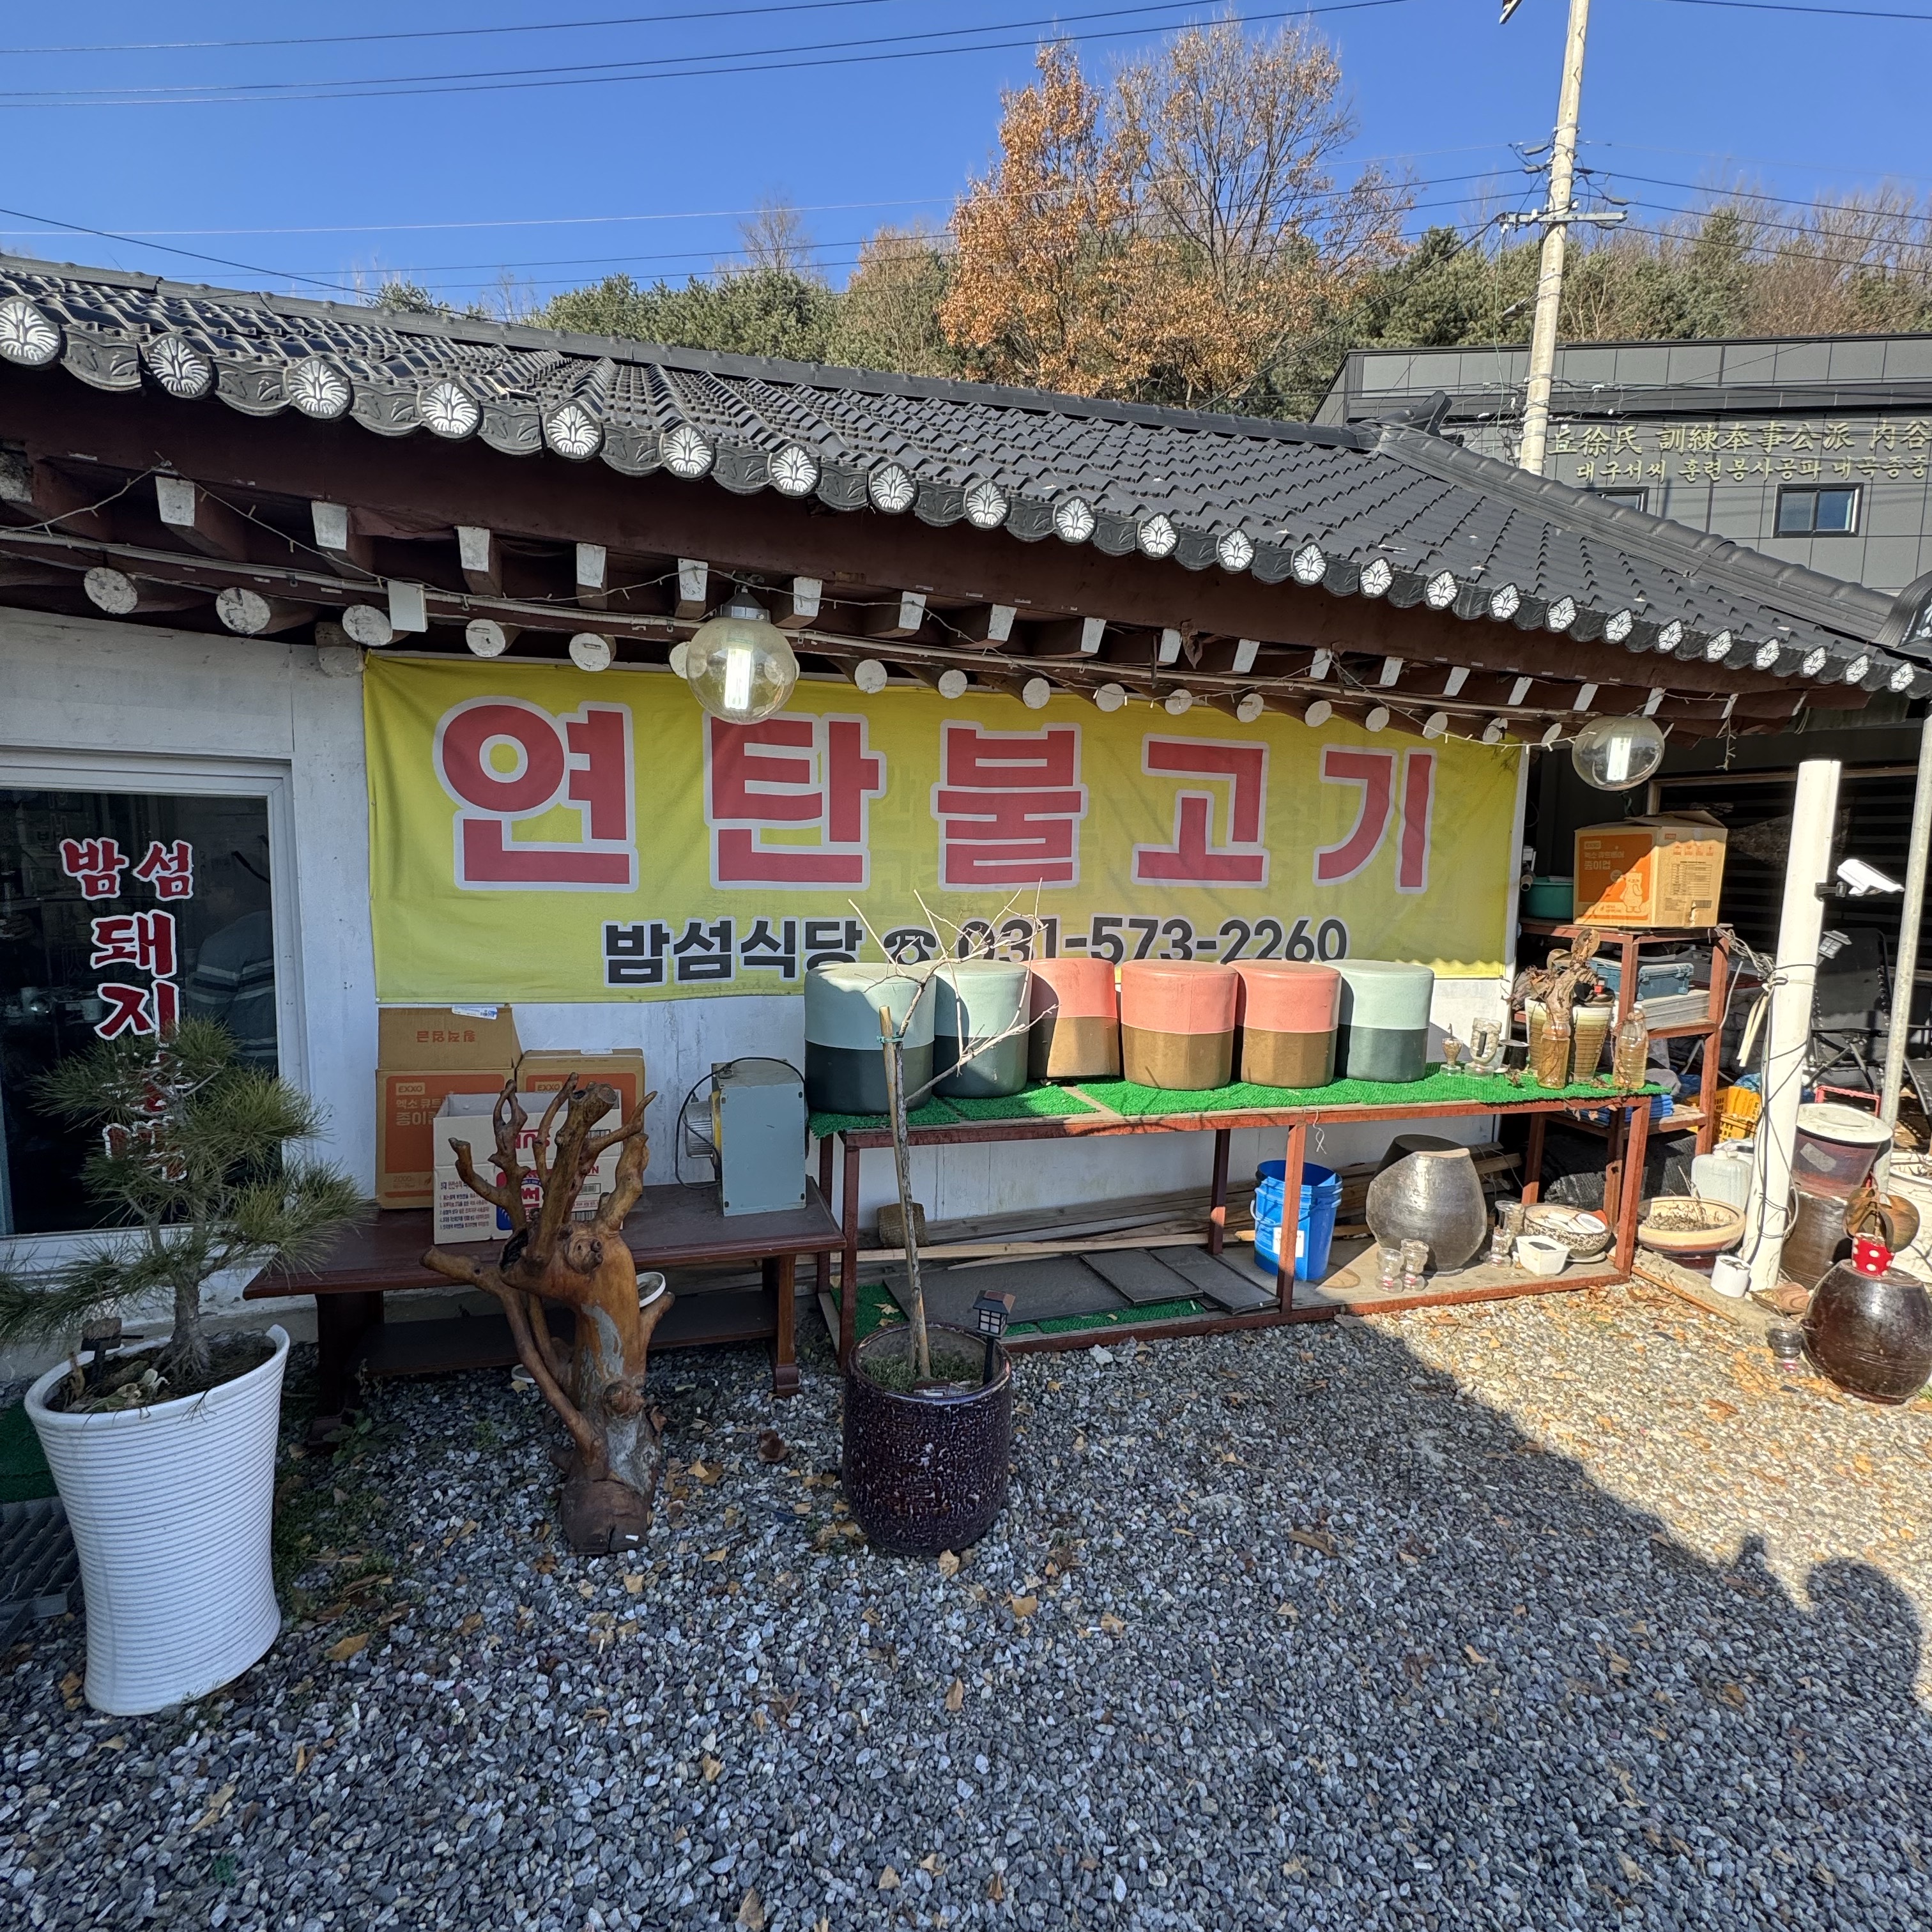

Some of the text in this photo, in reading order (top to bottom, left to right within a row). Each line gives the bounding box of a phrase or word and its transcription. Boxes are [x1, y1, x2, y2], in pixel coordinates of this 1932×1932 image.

[1576, 459, 1667, 484] 대구서씨
[1678, 457, 1822, 482] 훈련봉사공파
[434, 698, 1435, 893] 연탄불고기
[60, 838, 193, 901] 밤섬
[604, 915, 1348, 987] 밤섬식당 031-573-2260
[395, 1098, 442, 1109] 엑소 큐트
[398, 1084, 423, 1092] EXXO
